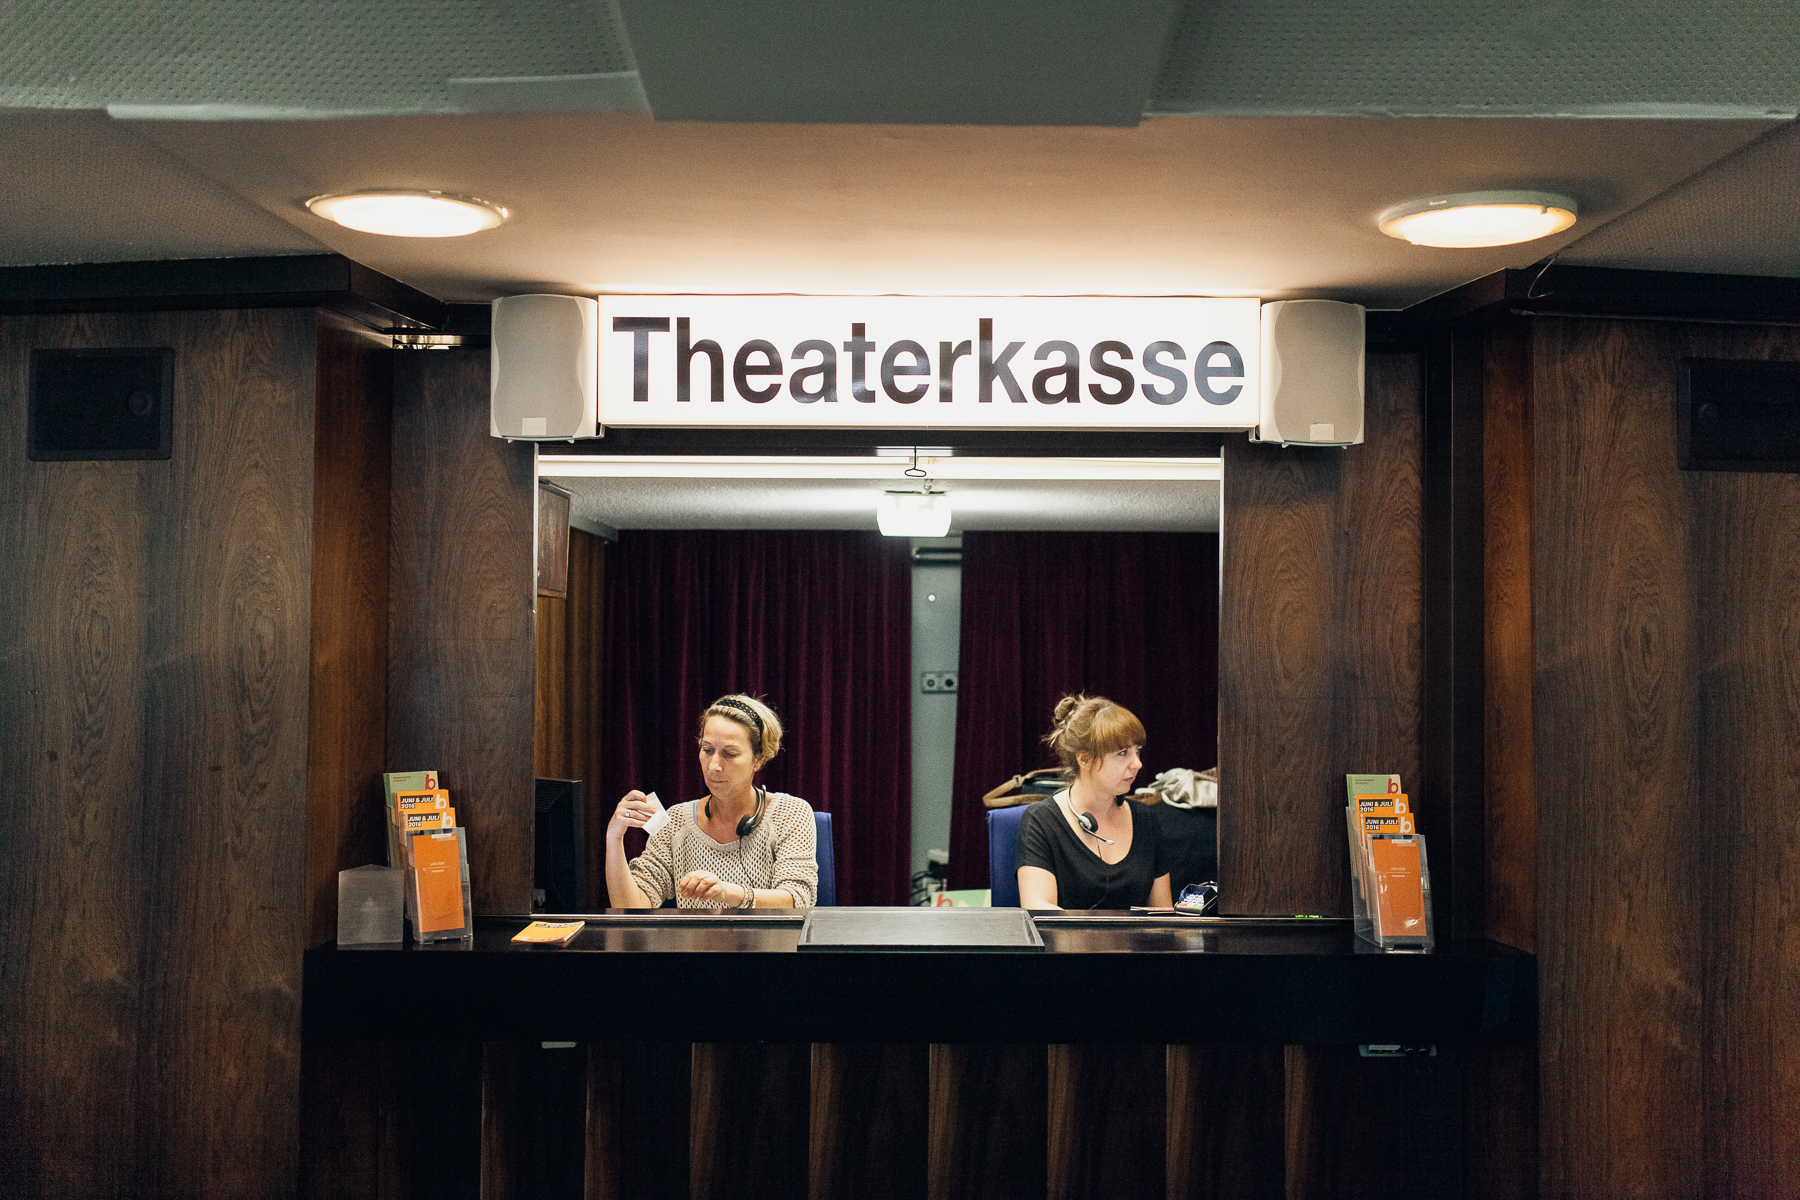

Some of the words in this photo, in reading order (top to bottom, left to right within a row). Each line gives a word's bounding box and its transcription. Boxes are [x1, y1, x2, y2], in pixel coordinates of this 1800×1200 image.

[612, 316, 1246, 405] Theaterkasse
[425, 774, 436, 790] b
[1388, 778, 1399, 794] b
[435, 793, 447, 809] b
[1394, 798, 1407, 814] b
[441, 811, 454, 828] b
[1400, 816, 1412, 833] b
